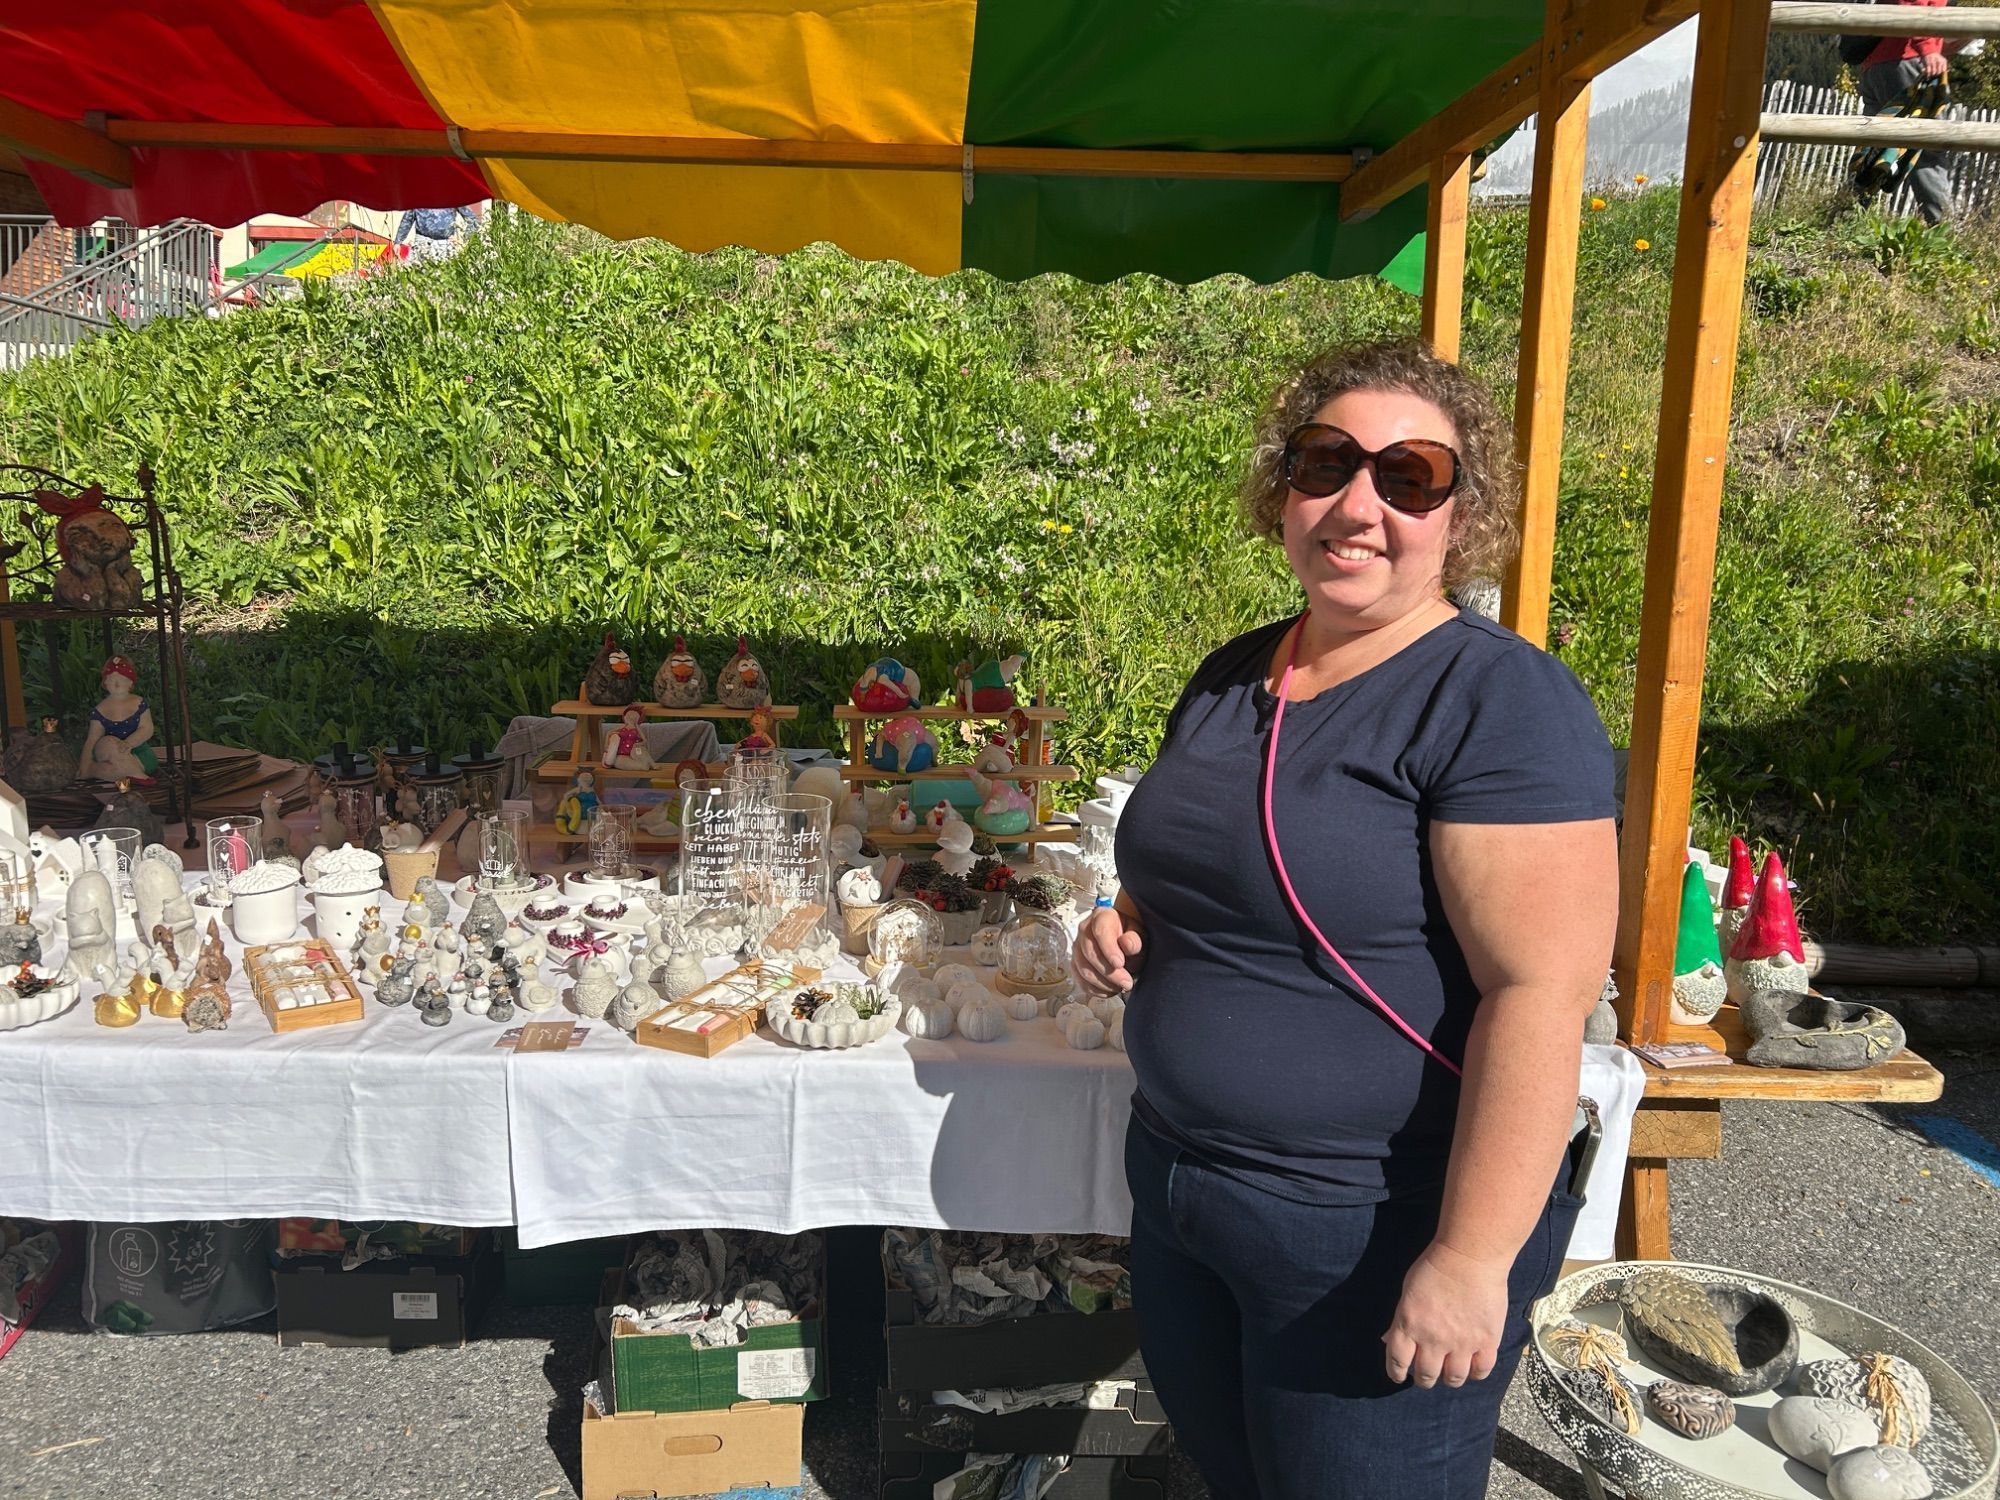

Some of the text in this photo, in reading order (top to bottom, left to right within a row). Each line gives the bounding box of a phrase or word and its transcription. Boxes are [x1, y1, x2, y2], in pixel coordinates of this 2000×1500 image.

[791, 826, 822, 852] stets
[684, 841, 704, 853] ZEIT
[773, 845, 800, 857] MUTIG
[690, 855, 734, 865] LIEBEN UND
[770, 866, 806, 879] EHRLICH
